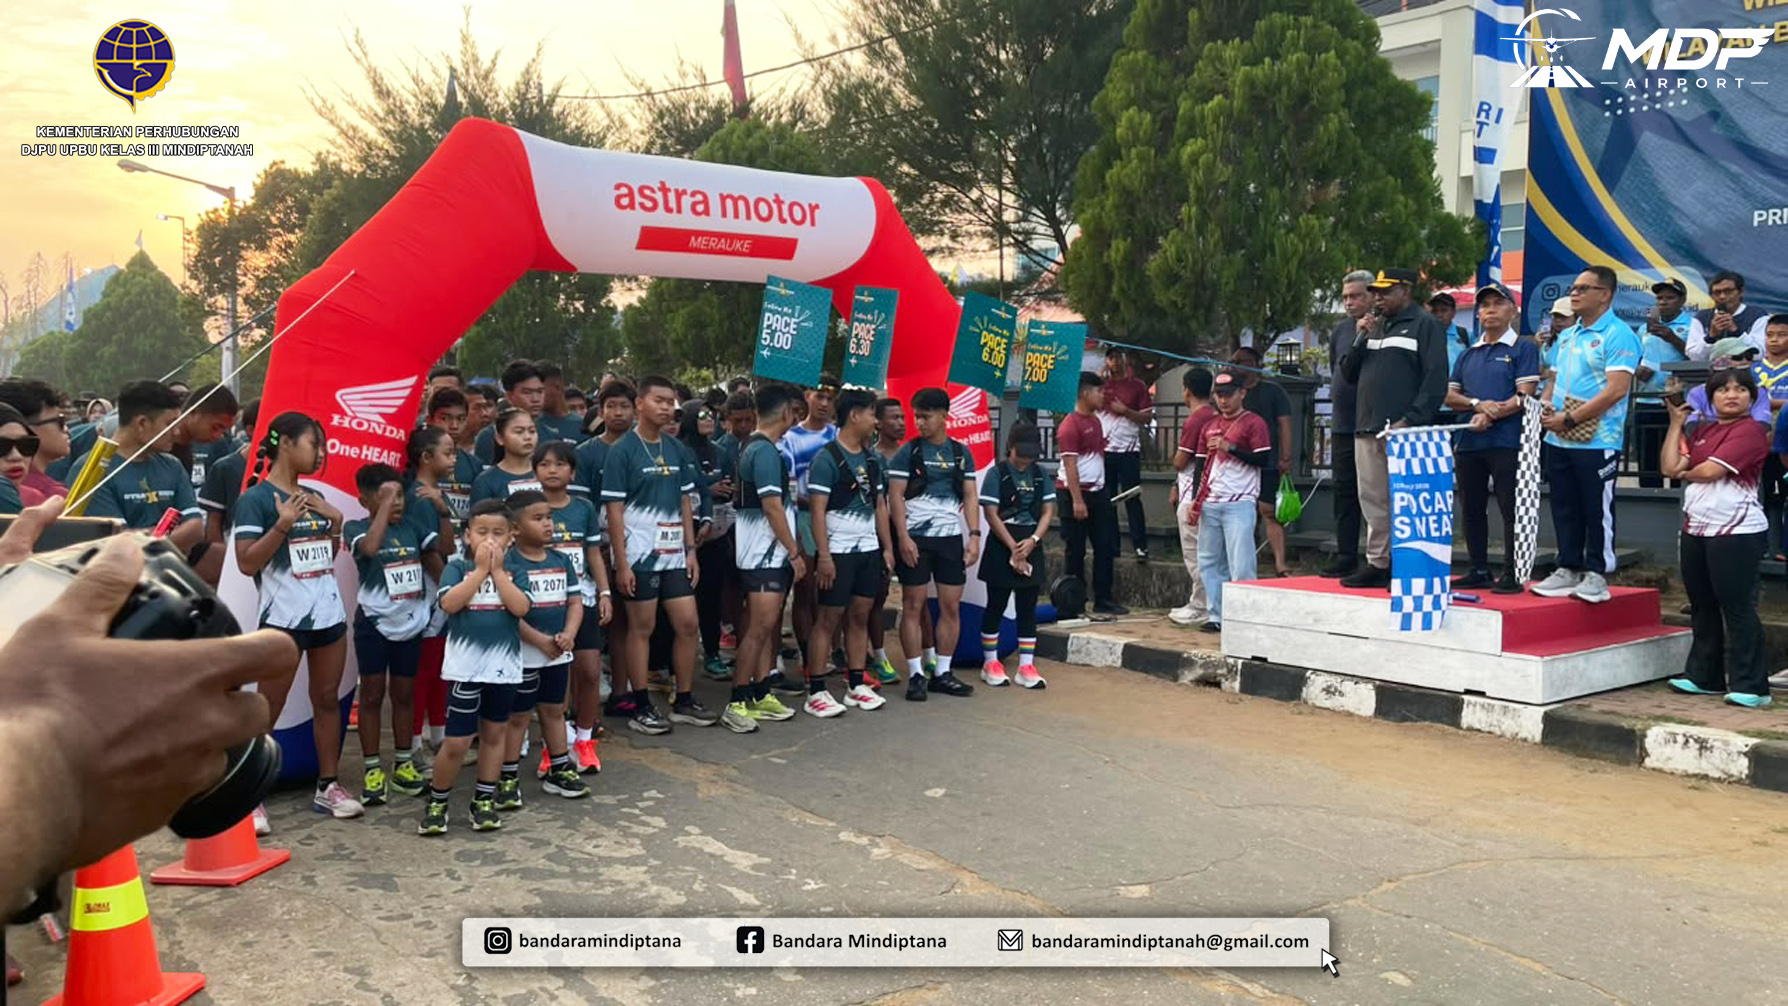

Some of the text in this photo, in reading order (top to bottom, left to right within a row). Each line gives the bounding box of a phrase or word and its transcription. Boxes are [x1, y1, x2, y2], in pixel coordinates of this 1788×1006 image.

[614, 180, 820, 228] astra motor
[688, 234, 752, 253] MERAUKE
[762, 312, 799, 335] PACE
[851, 321, 876, 342] PACE
[761, 329, 792, 350] 5.00
[849, 337, 871, 357] 6.30
[980, 331, 1008, 354] PACE
[982, 346, 1006, 368] 6.00
[1026, 352, 1055, 370] PACE
[1024, 367, 1048, 382] 7.00
[330, 413, 406, 441] HONDA
[945, 413, 989, 429] HONDA
[326, 438, 402, 467] One HEART
[296, 548, 310, 561] W
[391, 571, 403, 584] W
[529, 580, 540, 593] M
